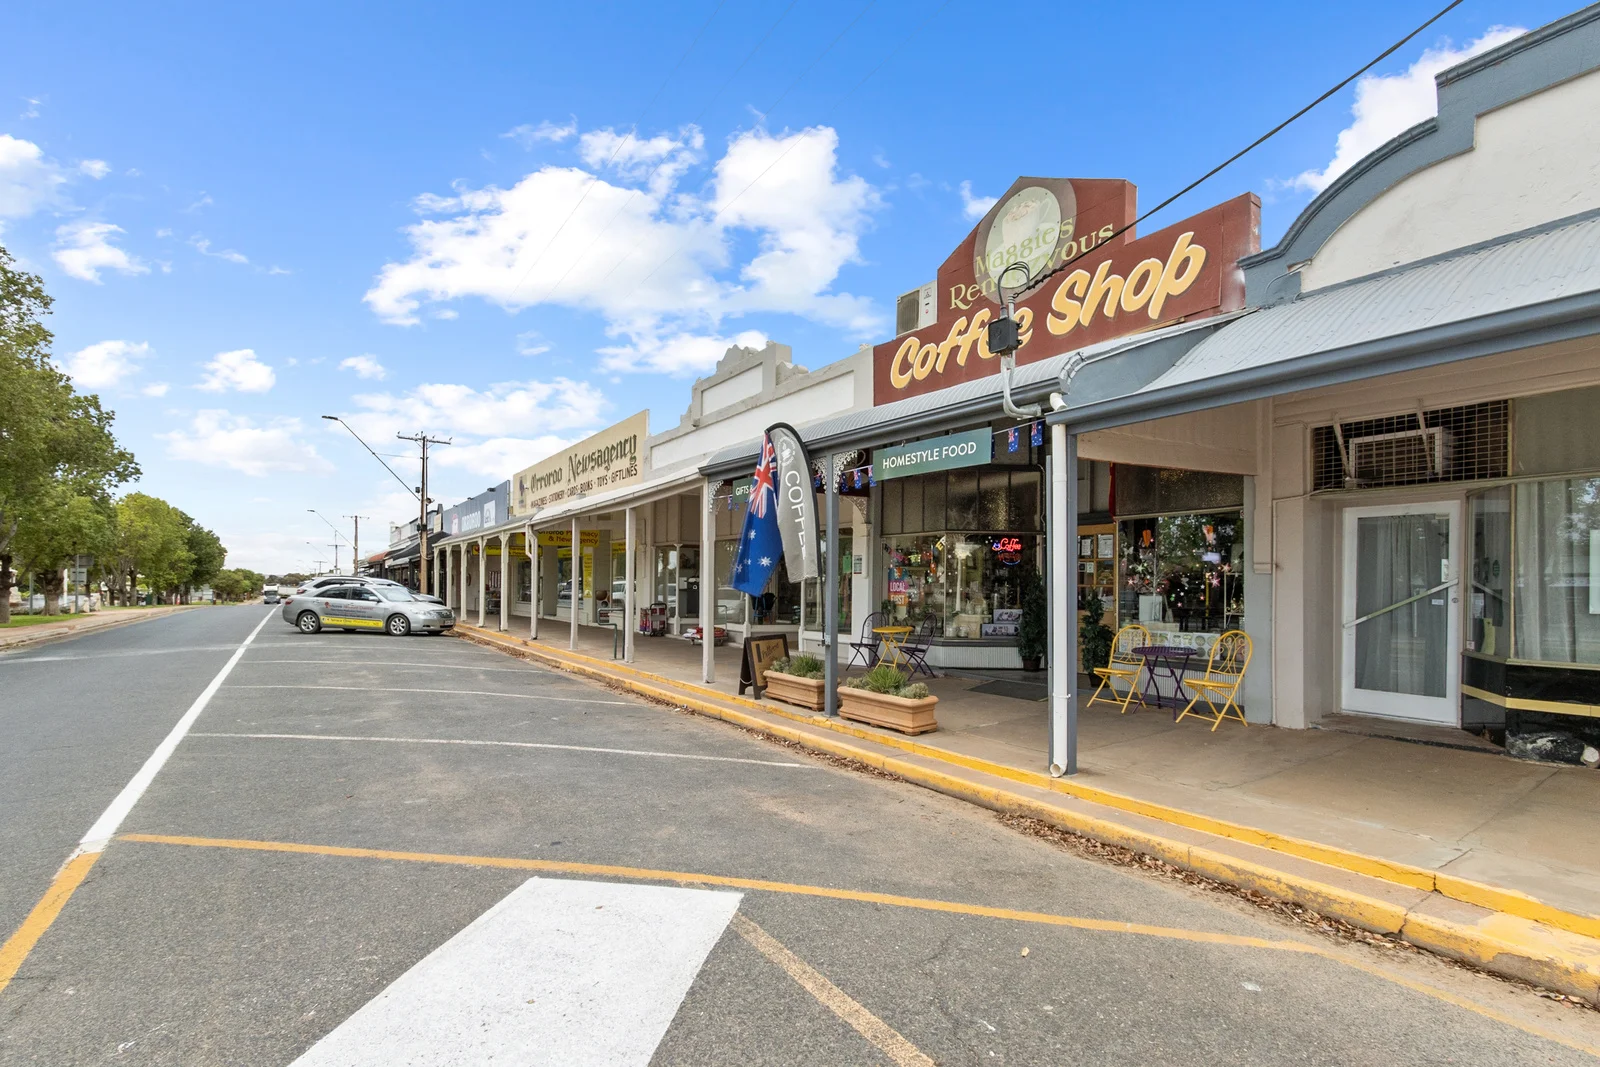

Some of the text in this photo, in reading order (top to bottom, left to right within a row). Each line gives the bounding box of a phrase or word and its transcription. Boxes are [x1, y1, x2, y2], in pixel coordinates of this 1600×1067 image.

[1046, 231, 1208, 336] Shop
[567, 434, 637, 486] Newsagency
[882, 442, 977, 469] HOMESTYLE FOOD
[567, 485, 579, 498] CARDS
[580, 480, 593, 493] BOOKS
[597, 474, 608, 488] TOYS
[611, 464, 638, 483] GIFTLINES
[735, 485, 749, 496] GIFTS
[556, 536, 598, 545] Newsgency
[565, 530, 598, 538] Pmacy
[1000, 537, 1022, 552] Coffee
[889, 581, 906, 592] LOCAL
